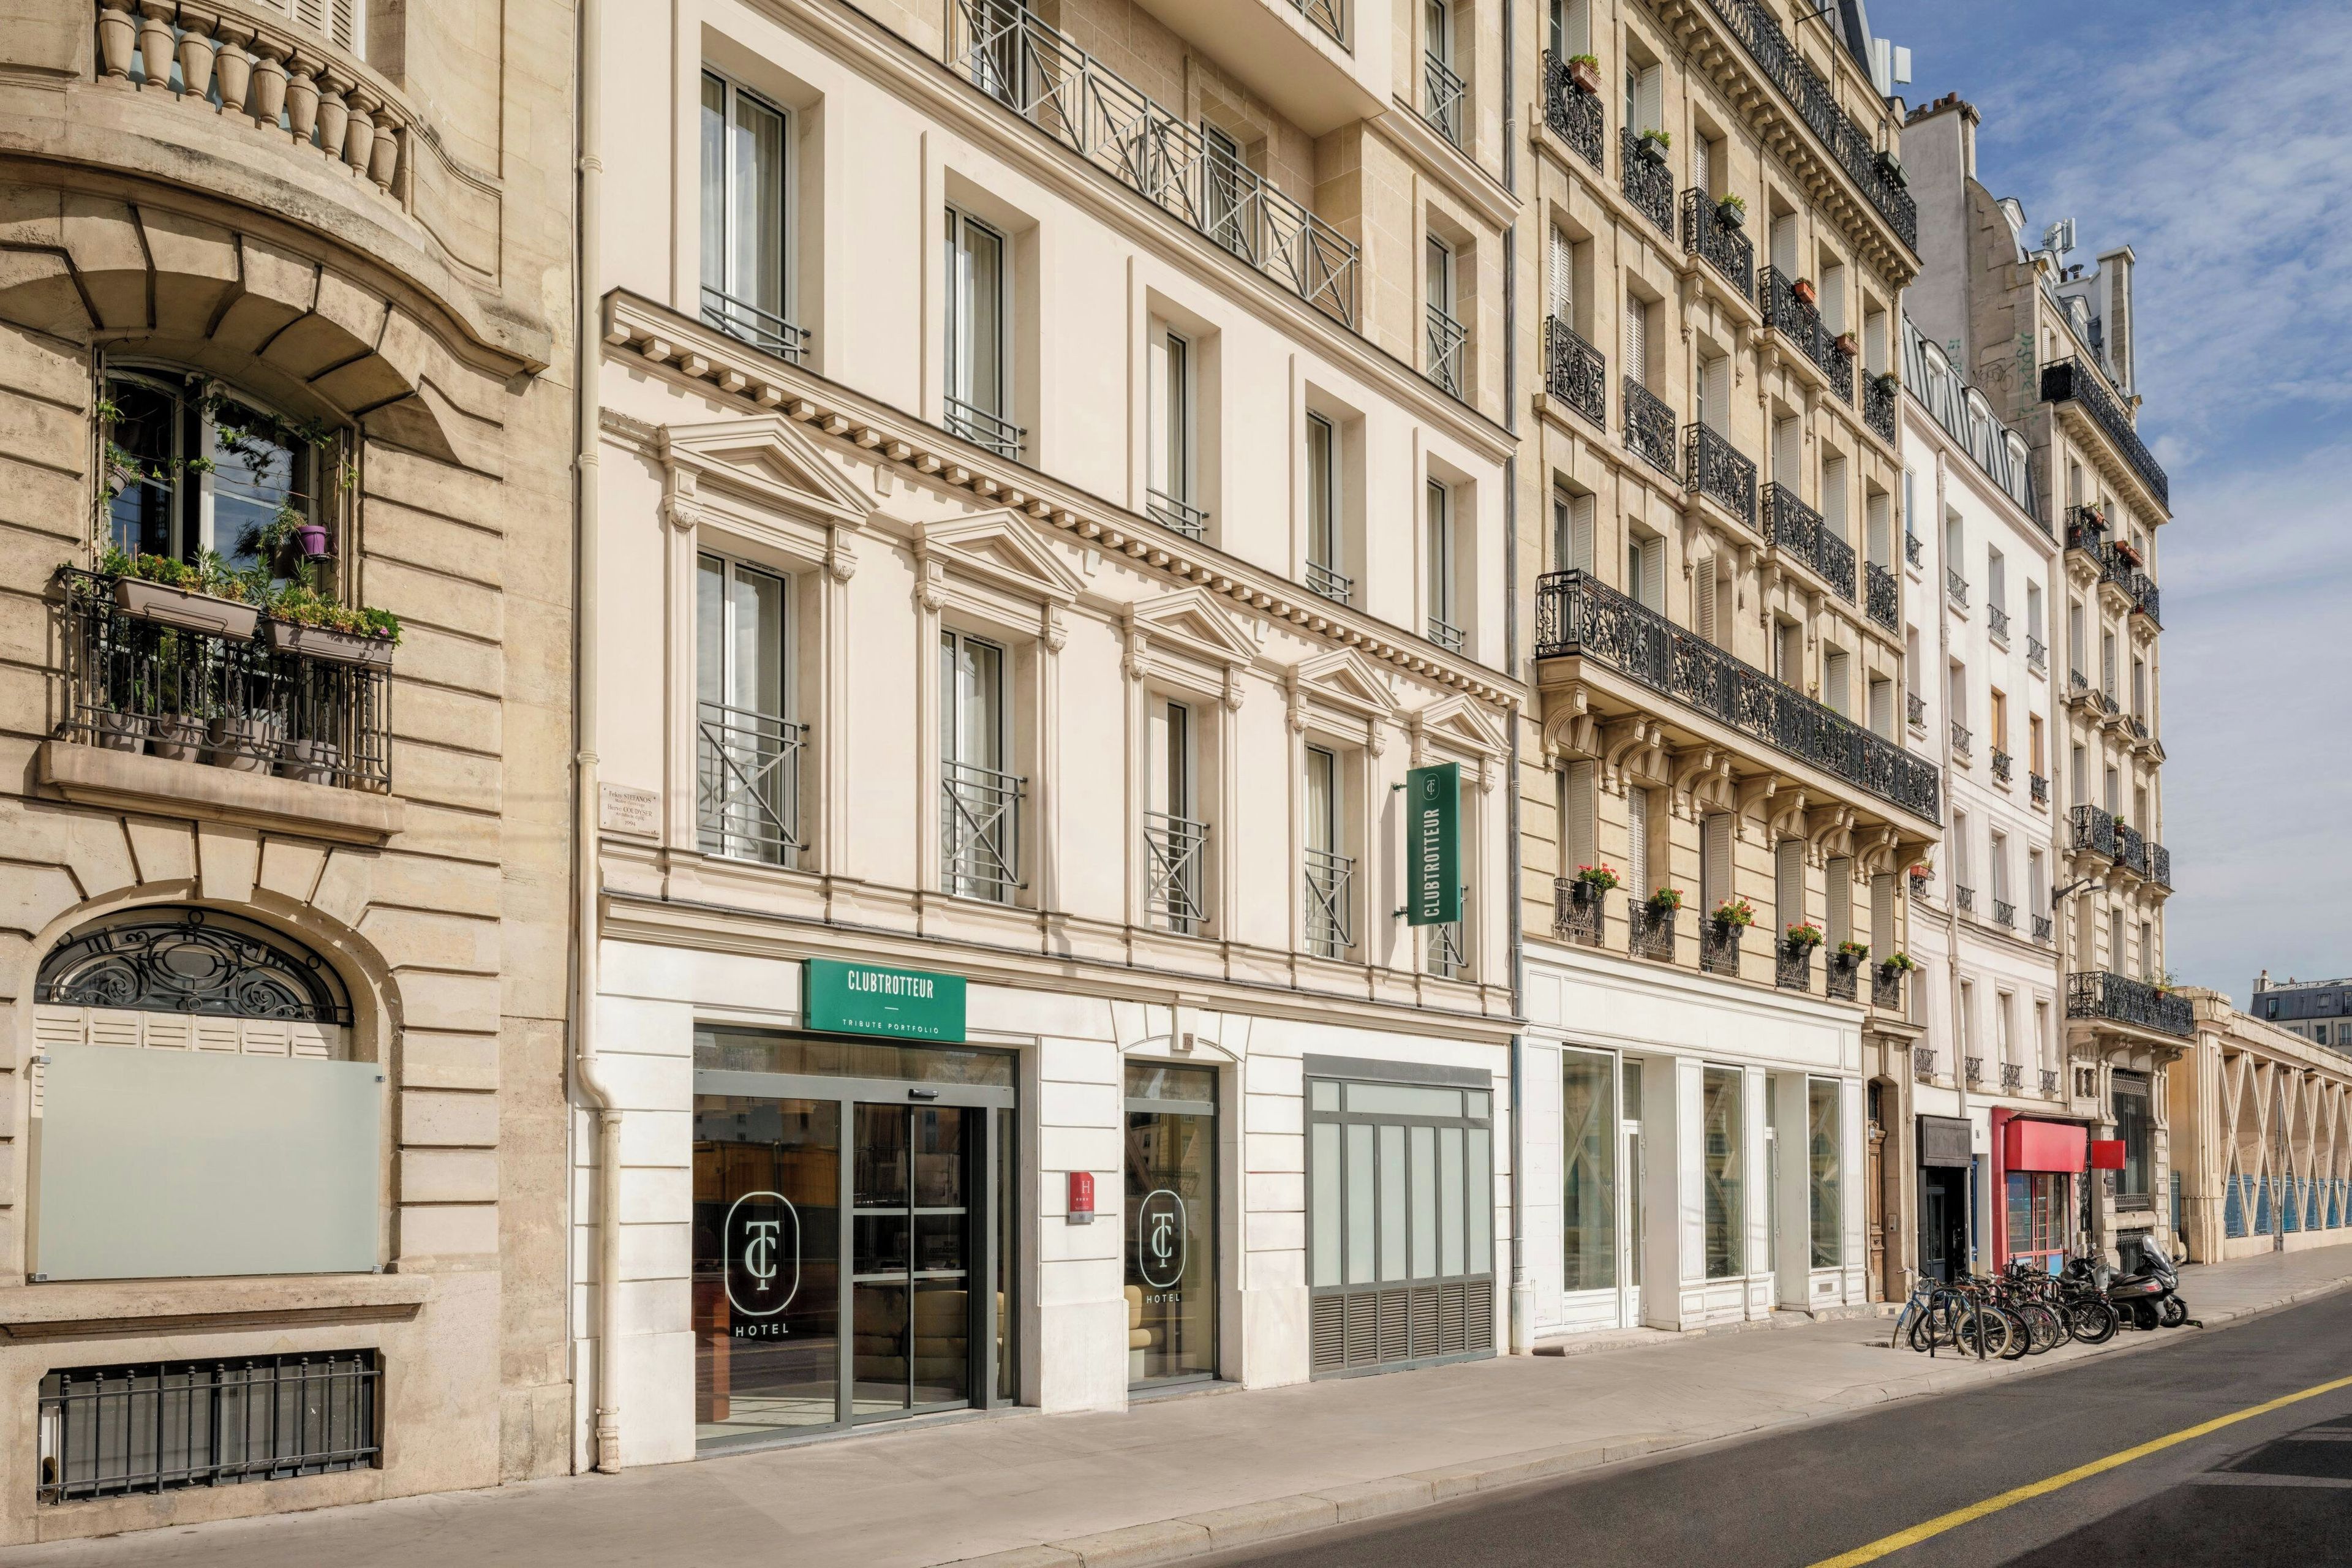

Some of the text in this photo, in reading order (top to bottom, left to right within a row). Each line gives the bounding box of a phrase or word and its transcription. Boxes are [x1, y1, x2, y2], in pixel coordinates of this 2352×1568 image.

[1423, 808, 1440, 918] CLUBTROTTEUR
[848, 970, 933, 999] CLUBTROTTEUR
[842, 1019, 939, 1035] TRIBUTE PORTFOLIO
[1082, 1180, 1090, 1194] H
[1147, 1293, 1180, 1304] HOTEL
[736, 1323, 789, 1337] HOTEL
